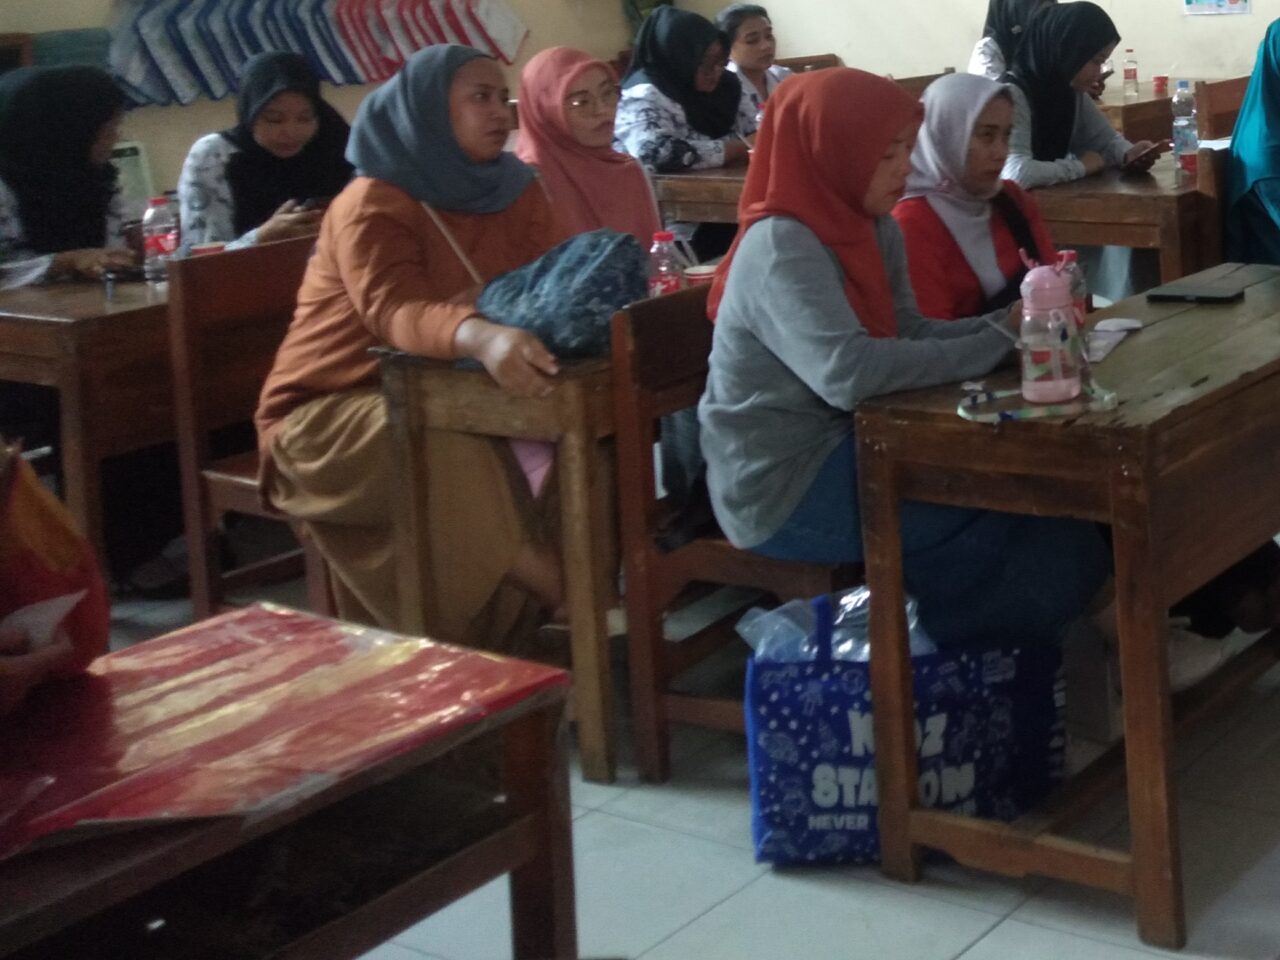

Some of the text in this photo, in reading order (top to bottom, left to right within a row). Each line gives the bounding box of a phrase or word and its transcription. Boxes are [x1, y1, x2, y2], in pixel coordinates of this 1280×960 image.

[847, 709, 948, 758] KZ
[811, 762, 976, 809] STAON
[807, 813, 870, 831] NEVER
